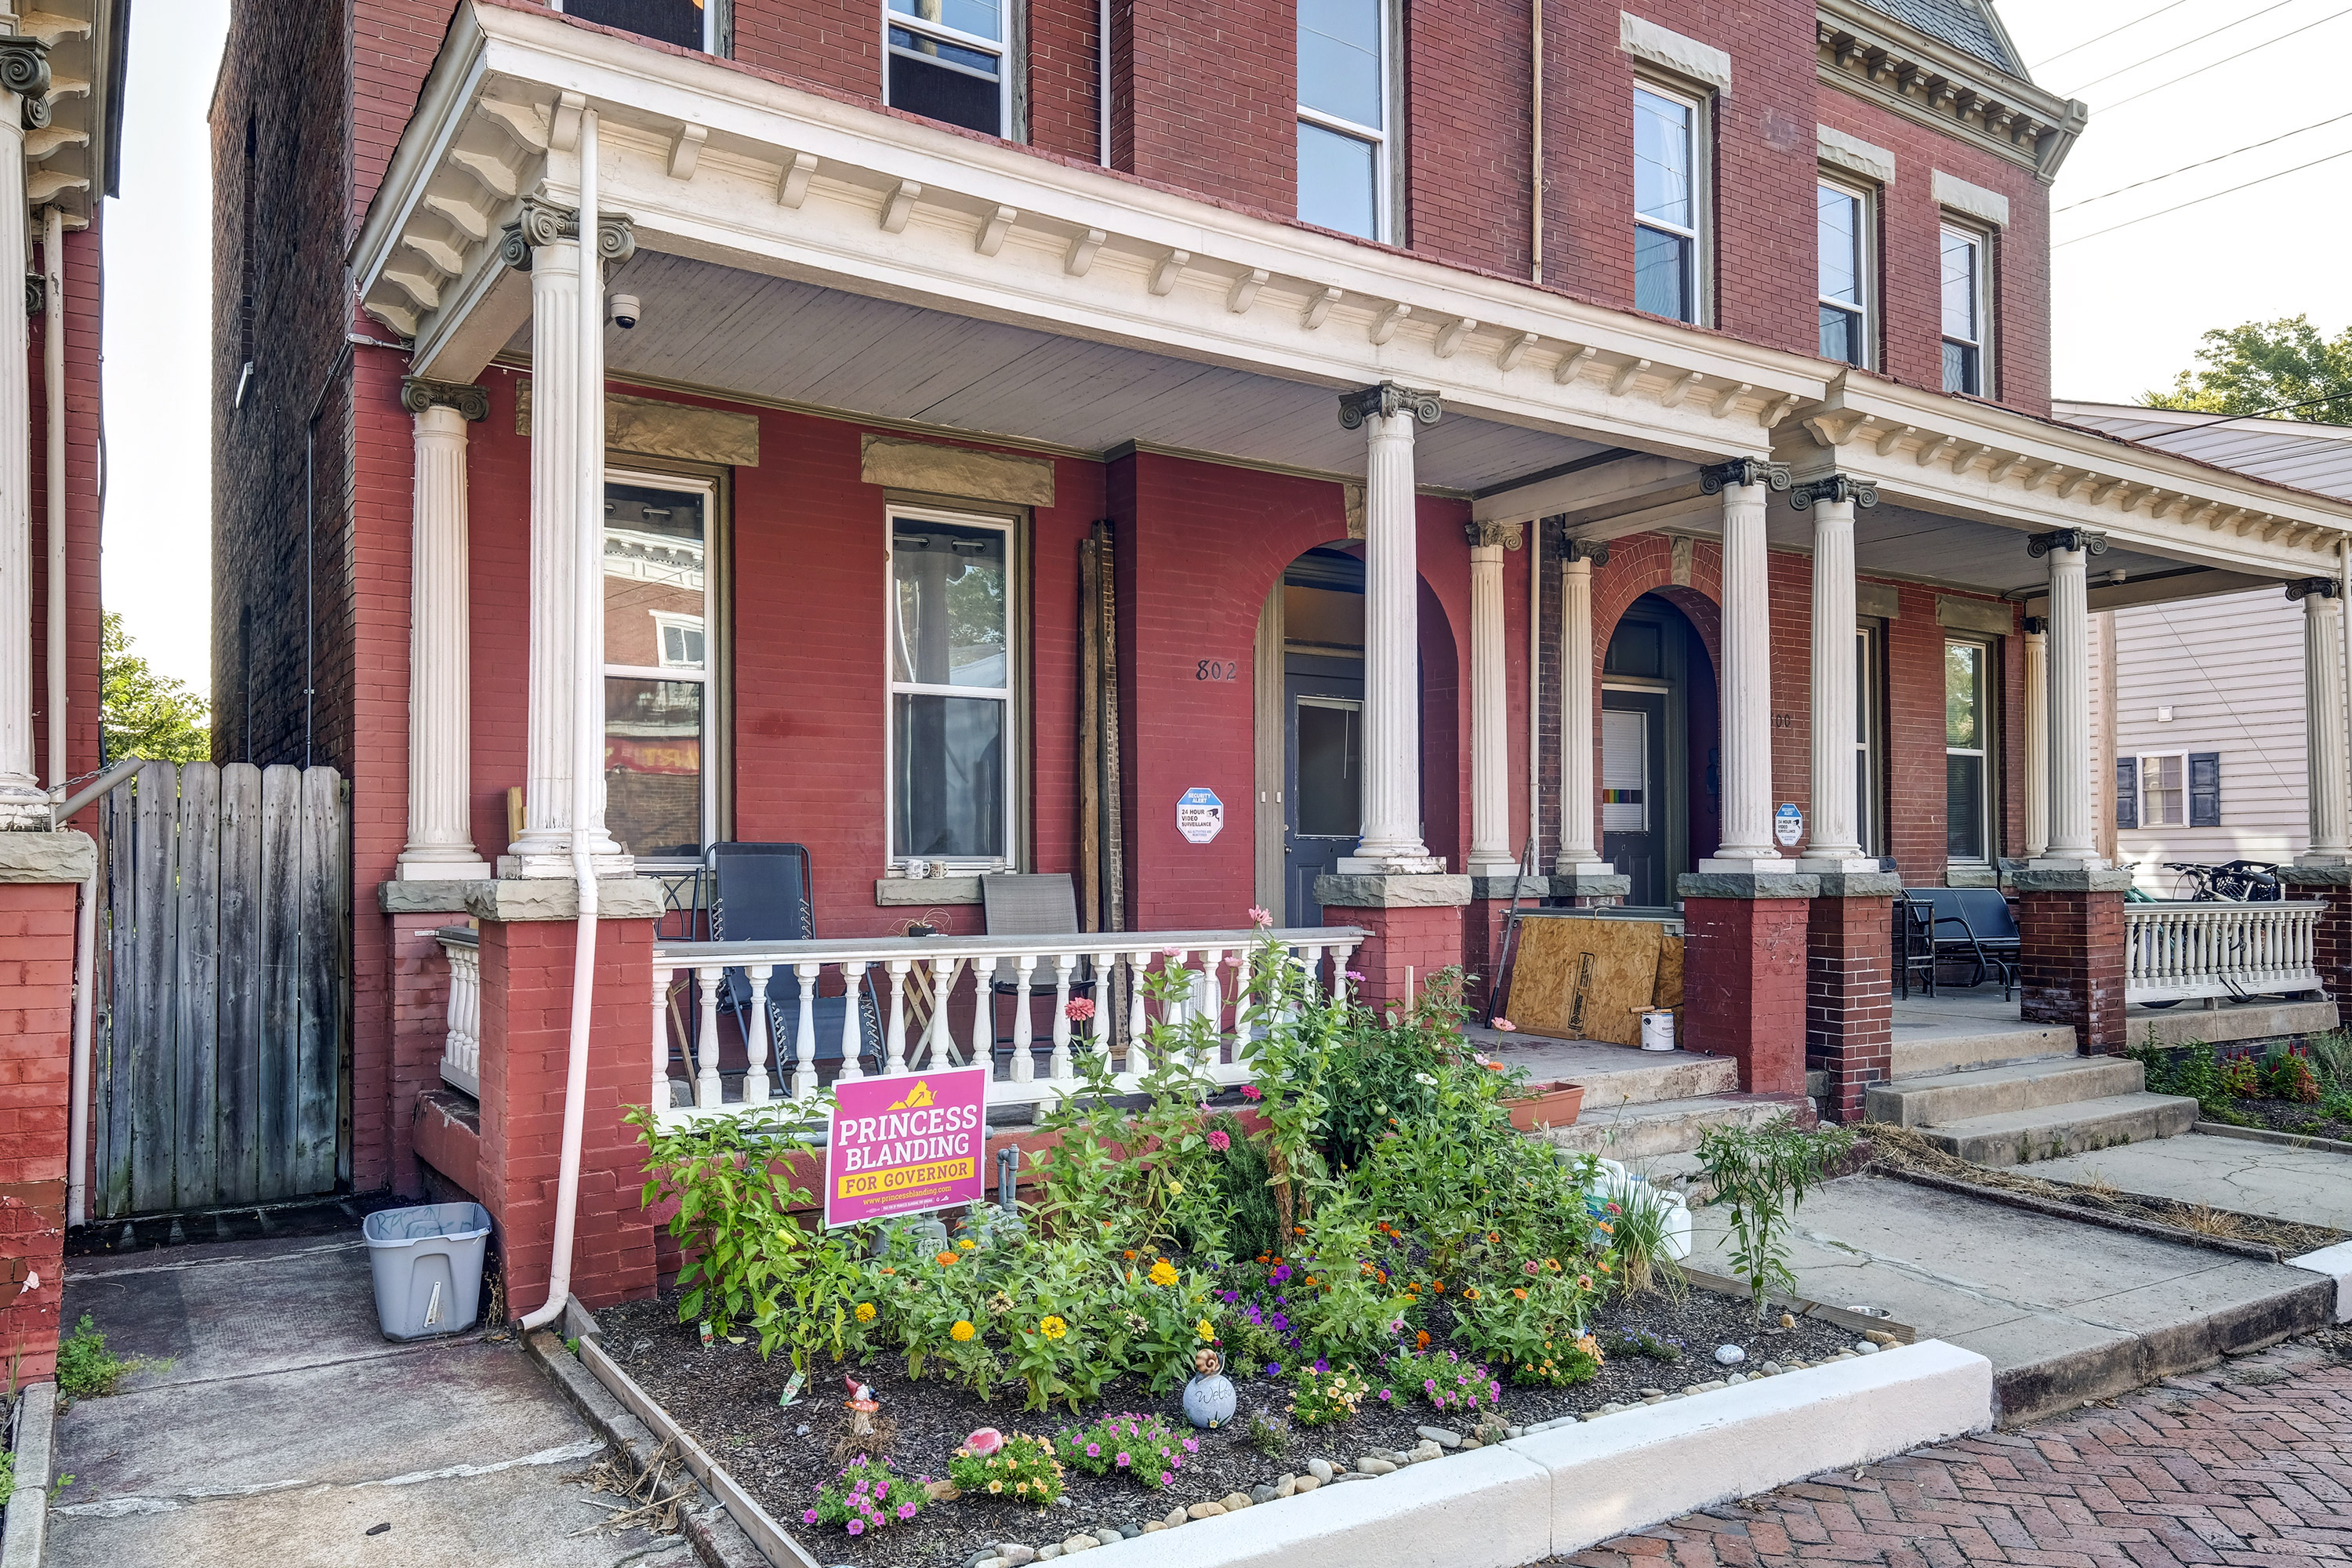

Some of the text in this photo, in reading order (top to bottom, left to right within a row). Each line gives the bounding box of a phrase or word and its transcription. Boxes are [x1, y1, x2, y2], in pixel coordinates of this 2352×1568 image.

[1196, 659, 1236, 681] 802
[838, 1104, 978, 1146] PRINCESS
[845, 1133, 970, 1171] BLANDING
[845, 1162, 968, 1194] FOR GOVERNOR
[862, 1185, 952, 1205] www.princessblanding.com
